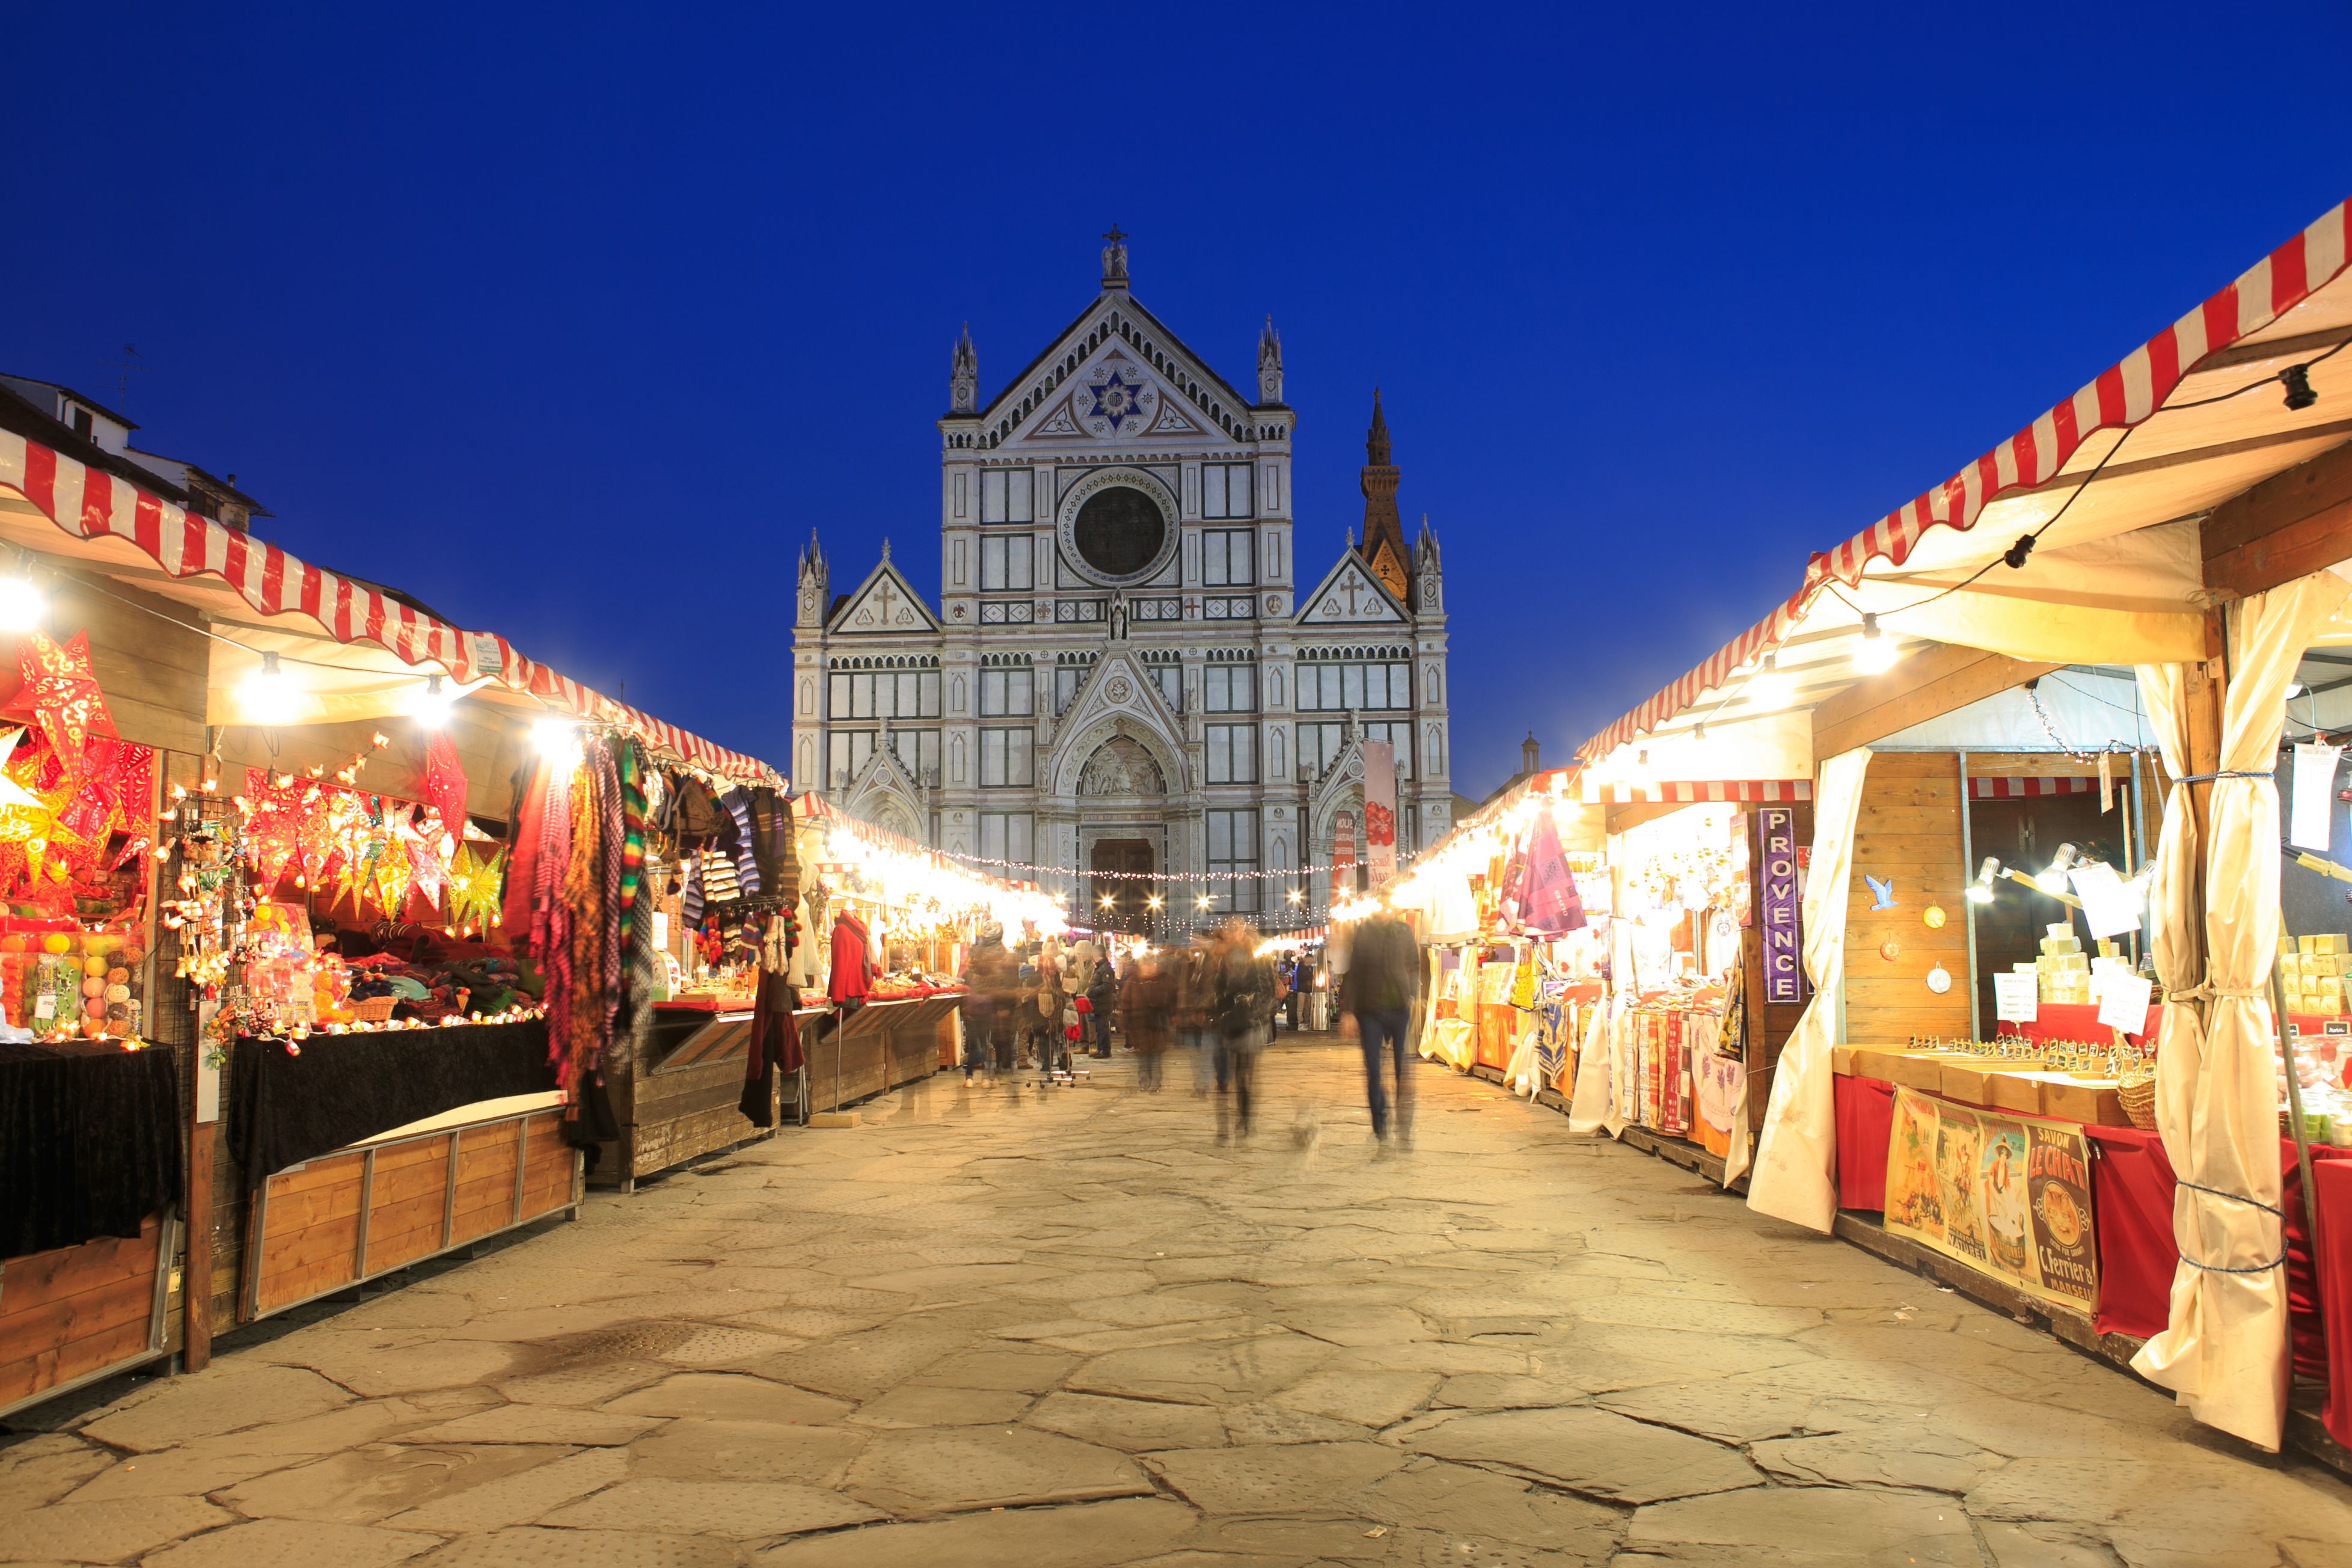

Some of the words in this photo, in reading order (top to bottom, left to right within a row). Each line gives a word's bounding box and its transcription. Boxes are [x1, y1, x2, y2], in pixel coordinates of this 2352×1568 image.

[1554, 889, 1569, 917] OLIVES
[1769, 813, 1794, 996] PROVENCE
[2037, 1128, 2069, 1150] SAVON
[2029, 1147, 2044, 1179] LE
[2044, 1147, 2086, 1191] CHAT
[1948, 1234, 1988, 1263] NATUREL
